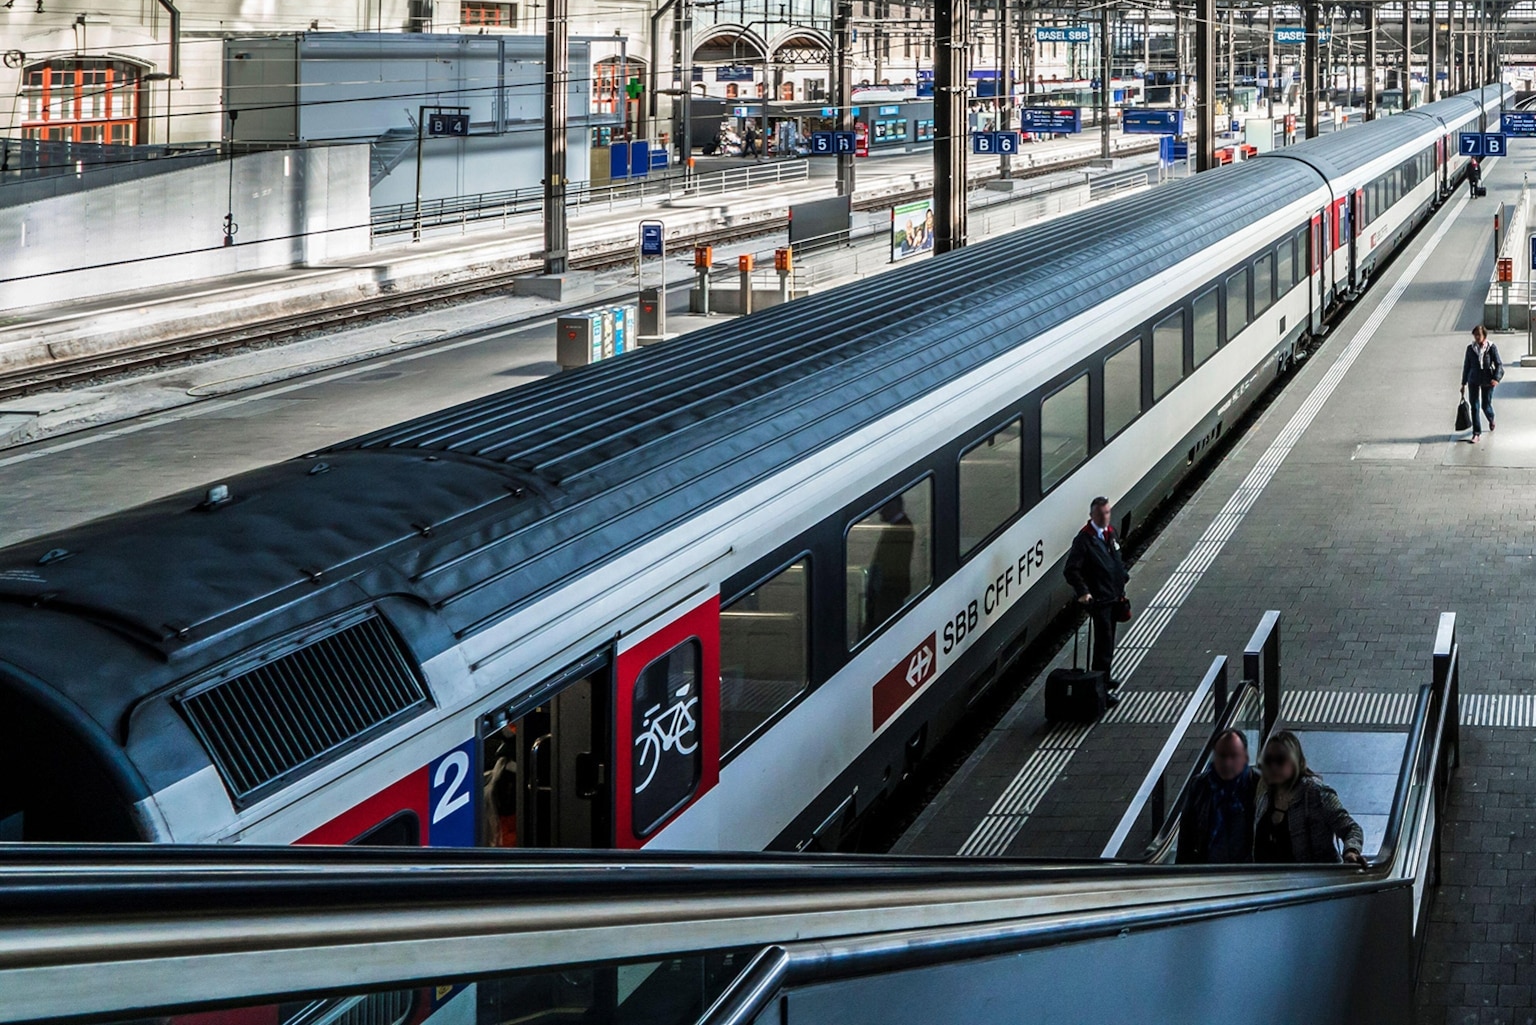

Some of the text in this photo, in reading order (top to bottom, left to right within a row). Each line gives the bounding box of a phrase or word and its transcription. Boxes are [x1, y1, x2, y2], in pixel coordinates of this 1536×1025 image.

[1037, 31, 1088, 40] BASEL SBB
[1277, 31, 1306, 41] BASEL
[434, 121, 443, 132] B
[453, 121, 463, 133] 4
[1505, 117, 1511, 125] 7
[818, 138, 827, 150] 5
[979, 139, 989, 151] B
[1001, 139, 1011, 151] 6
[1466, 140, 1475, 152] 7
[1489, 140, 1499, 152] B
[943, 539, 1044, 655] SBB CFF FFS
[432, 750, 470, 824] 2
